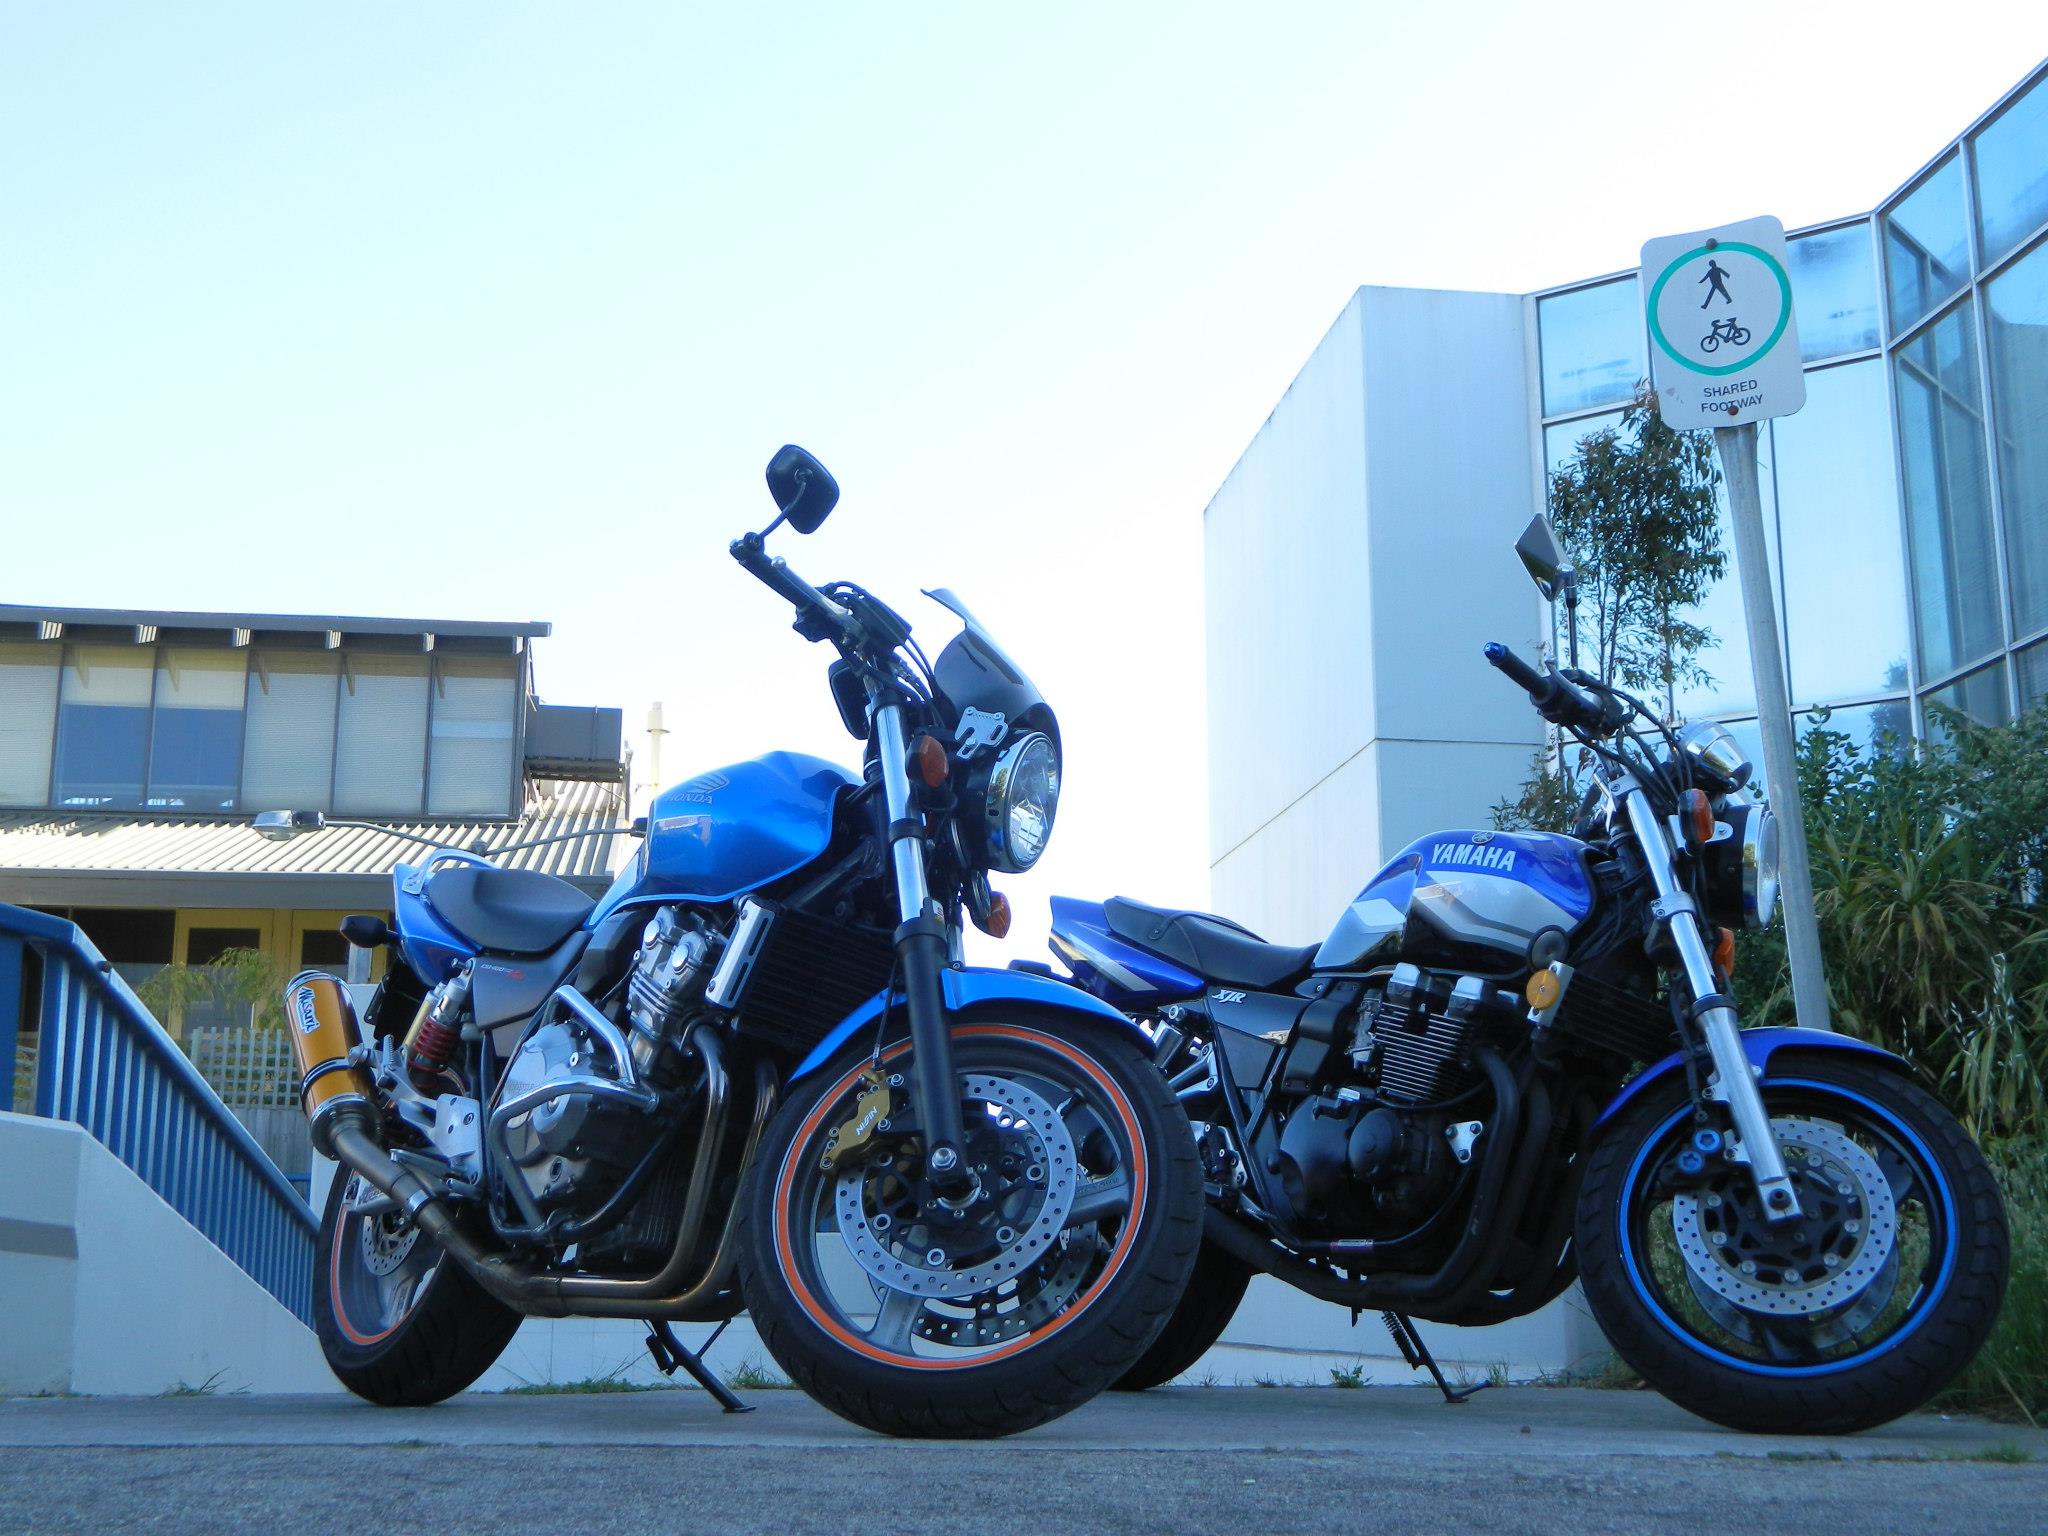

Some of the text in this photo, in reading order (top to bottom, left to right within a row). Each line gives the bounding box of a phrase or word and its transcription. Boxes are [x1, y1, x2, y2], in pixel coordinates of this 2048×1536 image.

[1703, 379, 1758, 398] SHARED
[1701, 393, 1764, 413] FOOTWAY
[1431, 843, 1517, 872] YAMAHA
[1211, 989, 1247, 1004] XJR
